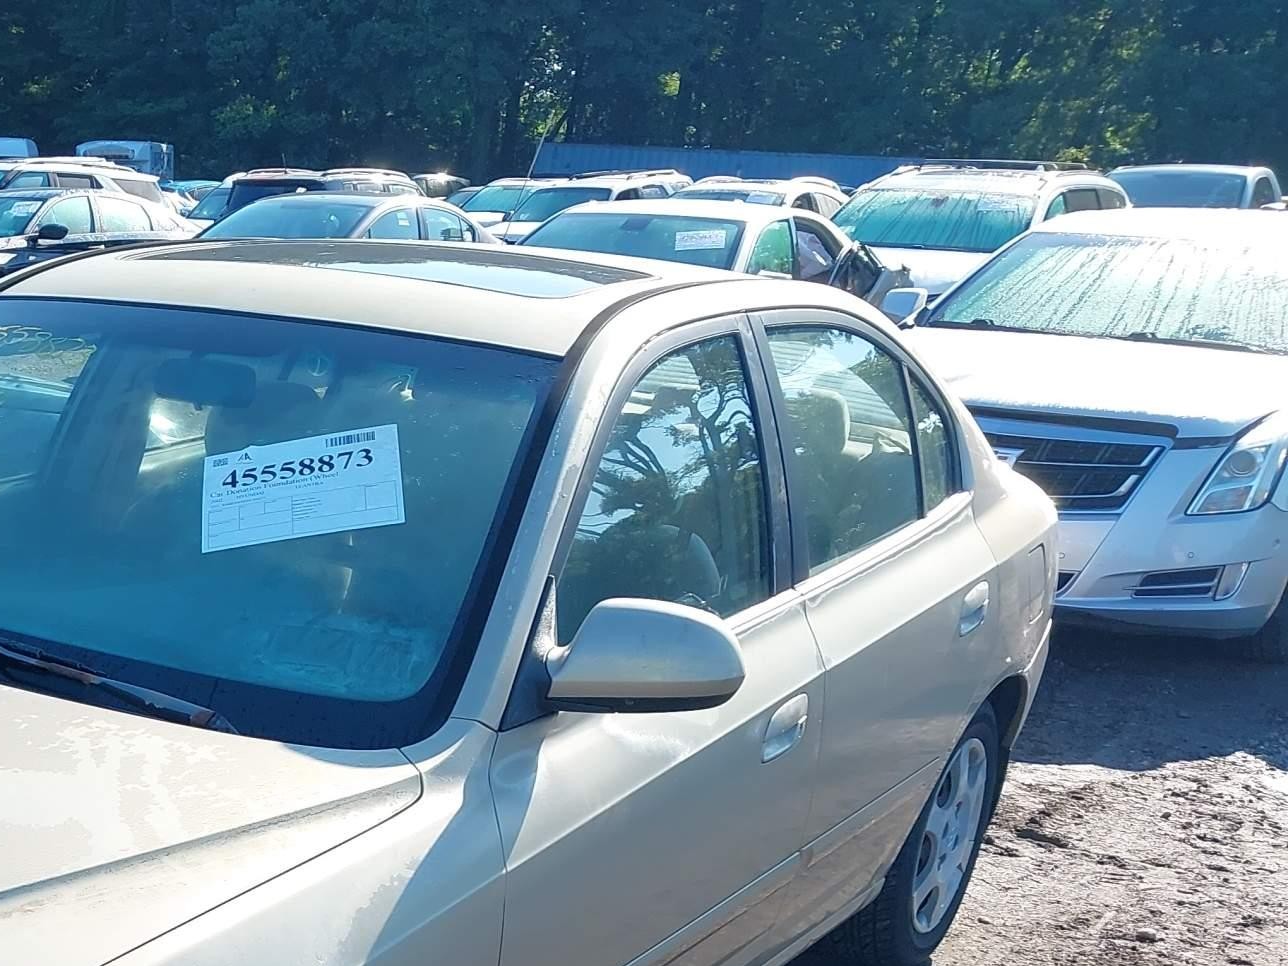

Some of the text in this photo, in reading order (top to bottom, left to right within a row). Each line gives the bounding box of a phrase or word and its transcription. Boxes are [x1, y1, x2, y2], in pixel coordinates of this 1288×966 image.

[222, 448, 374, 488] 45558873
[226, 485, 263, 496] Donation
[263, 478, 310, 488] Foundation
